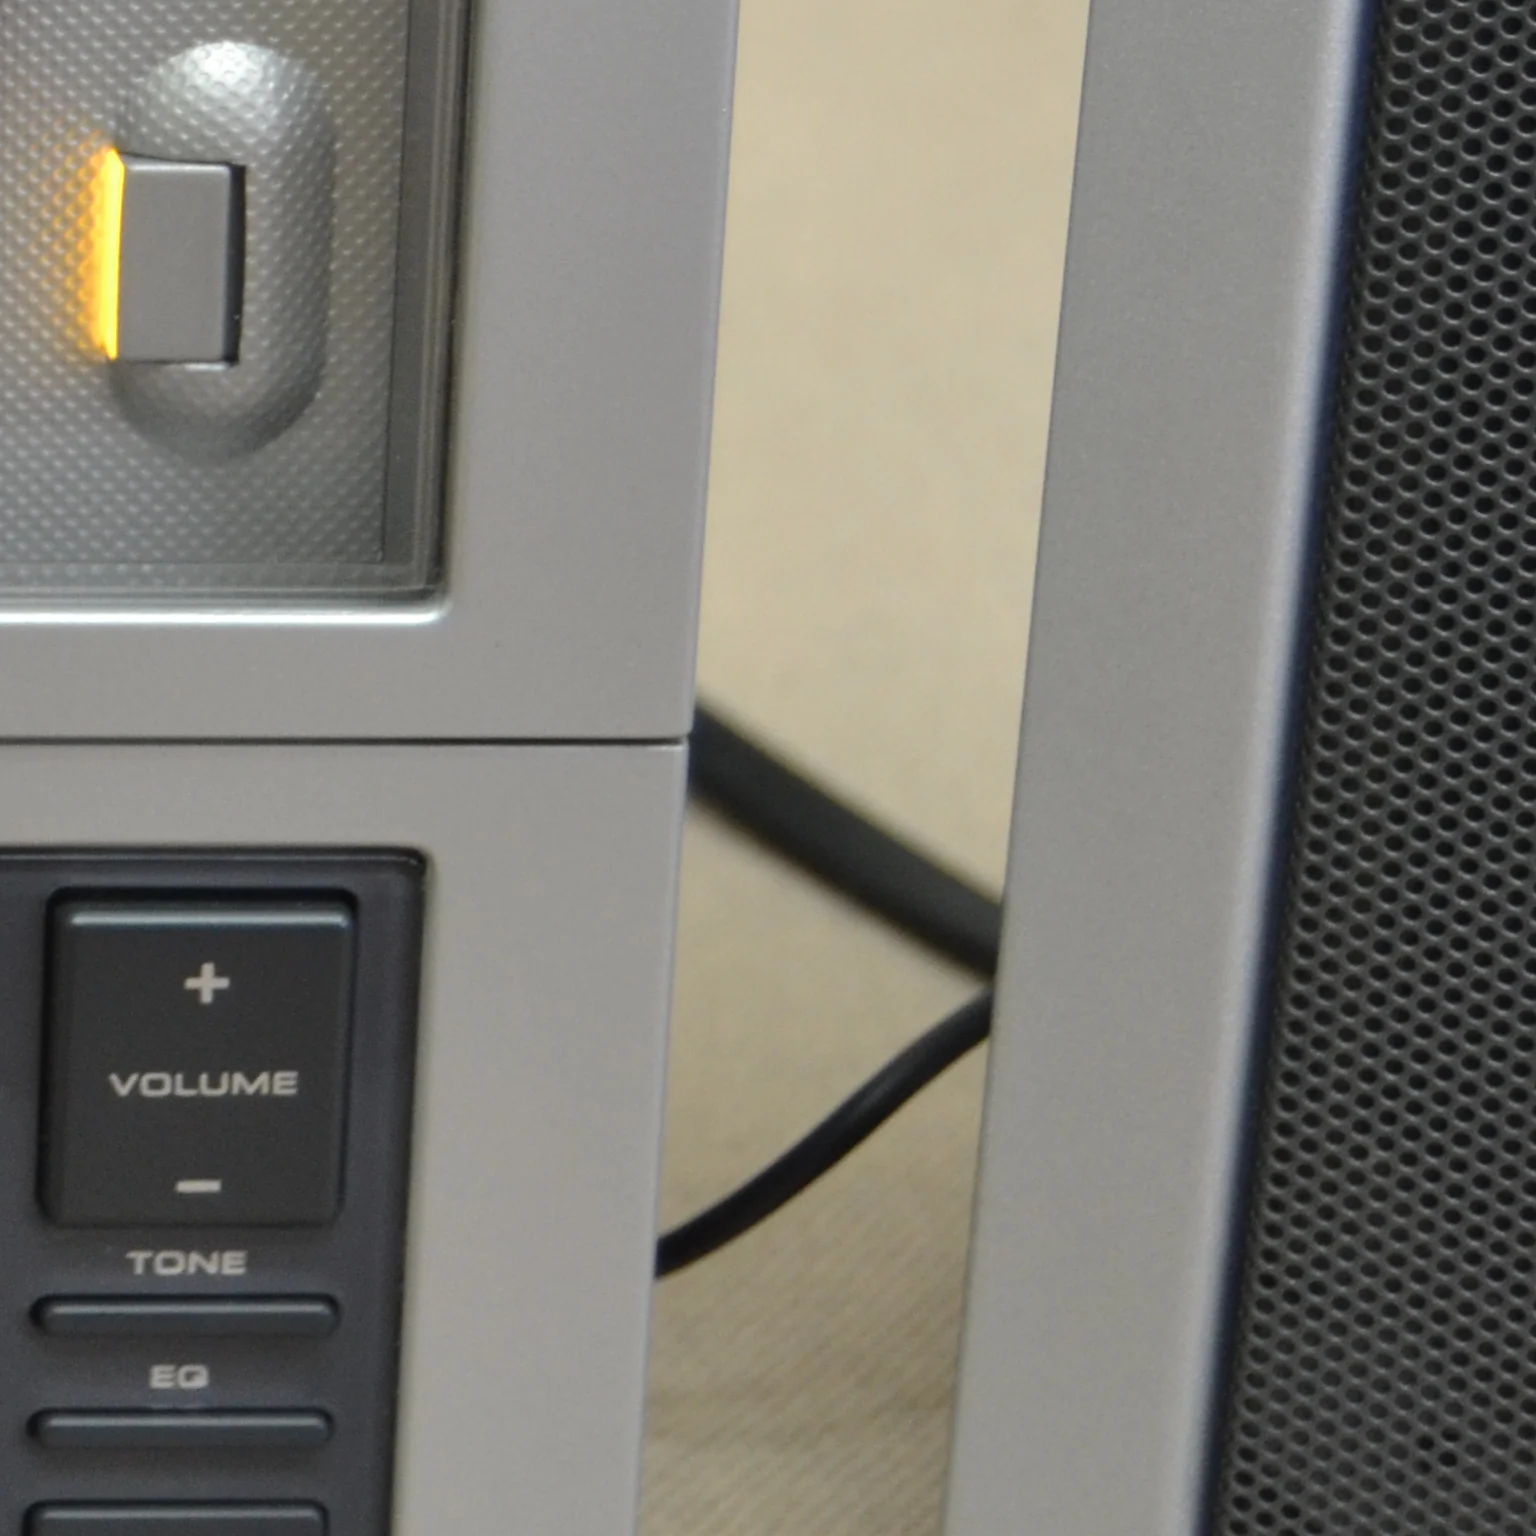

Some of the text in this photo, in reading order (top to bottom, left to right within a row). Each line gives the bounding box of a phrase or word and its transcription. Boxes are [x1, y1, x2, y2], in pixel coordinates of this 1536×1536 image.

[109, 1071, 299, 1097] VOLUME
[126, 1250, 248, 1276] TONE
[148, 1364, 210, 1389] EQ
